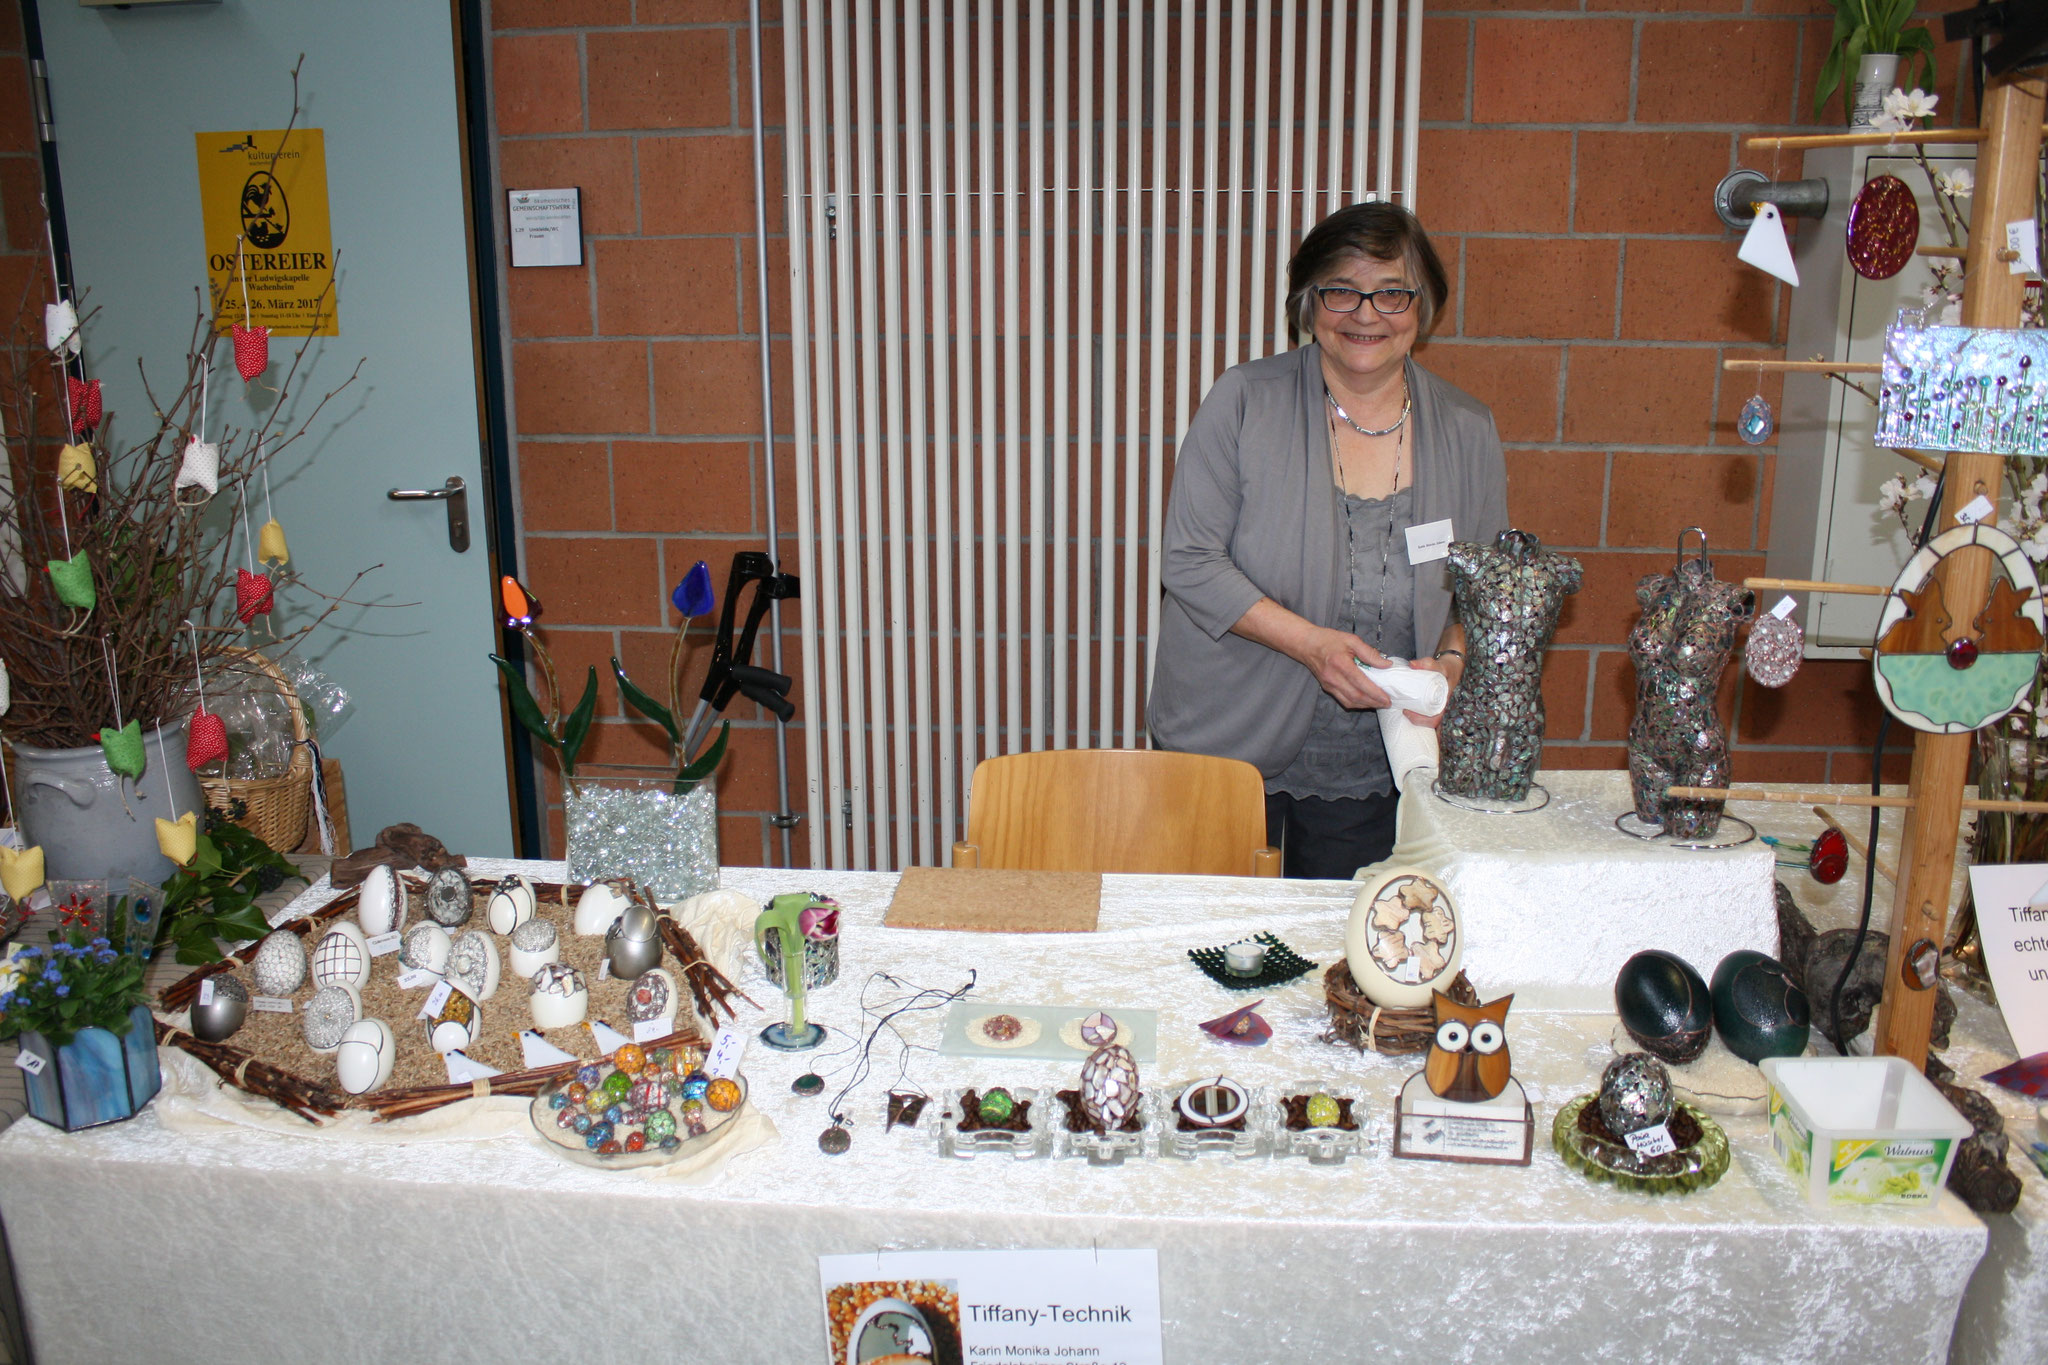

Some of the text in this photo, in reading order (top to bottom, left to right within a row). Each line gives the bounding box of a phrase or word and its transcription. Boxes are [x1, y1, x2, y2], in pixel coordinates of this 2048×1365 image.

[248, 151, 300, 160] kulturerein
[210, 253, 327, 271] OSTEREIER
[254, 274, 310, 283] Ludwigskapelle
[248, 283, 294, 291] Wachenheim
[225, 299, 240, 309] 25.
[251, 299, 266, 309] 26.
[268, 298, 294, 309] März
[297, 298, 320, 309] 2017
[2014, 936, 2048, 952] echt
[720, 1034, 736, 1049] 5,-
[716, 1049, 731, 1064] 4,-
[1884, 1144, 1934, 1156] Walnuss
[968, 1304, 1132, 1326] Tiffany-Technik
[969, 1345, 1100, 1357] Karin Monika Johann
